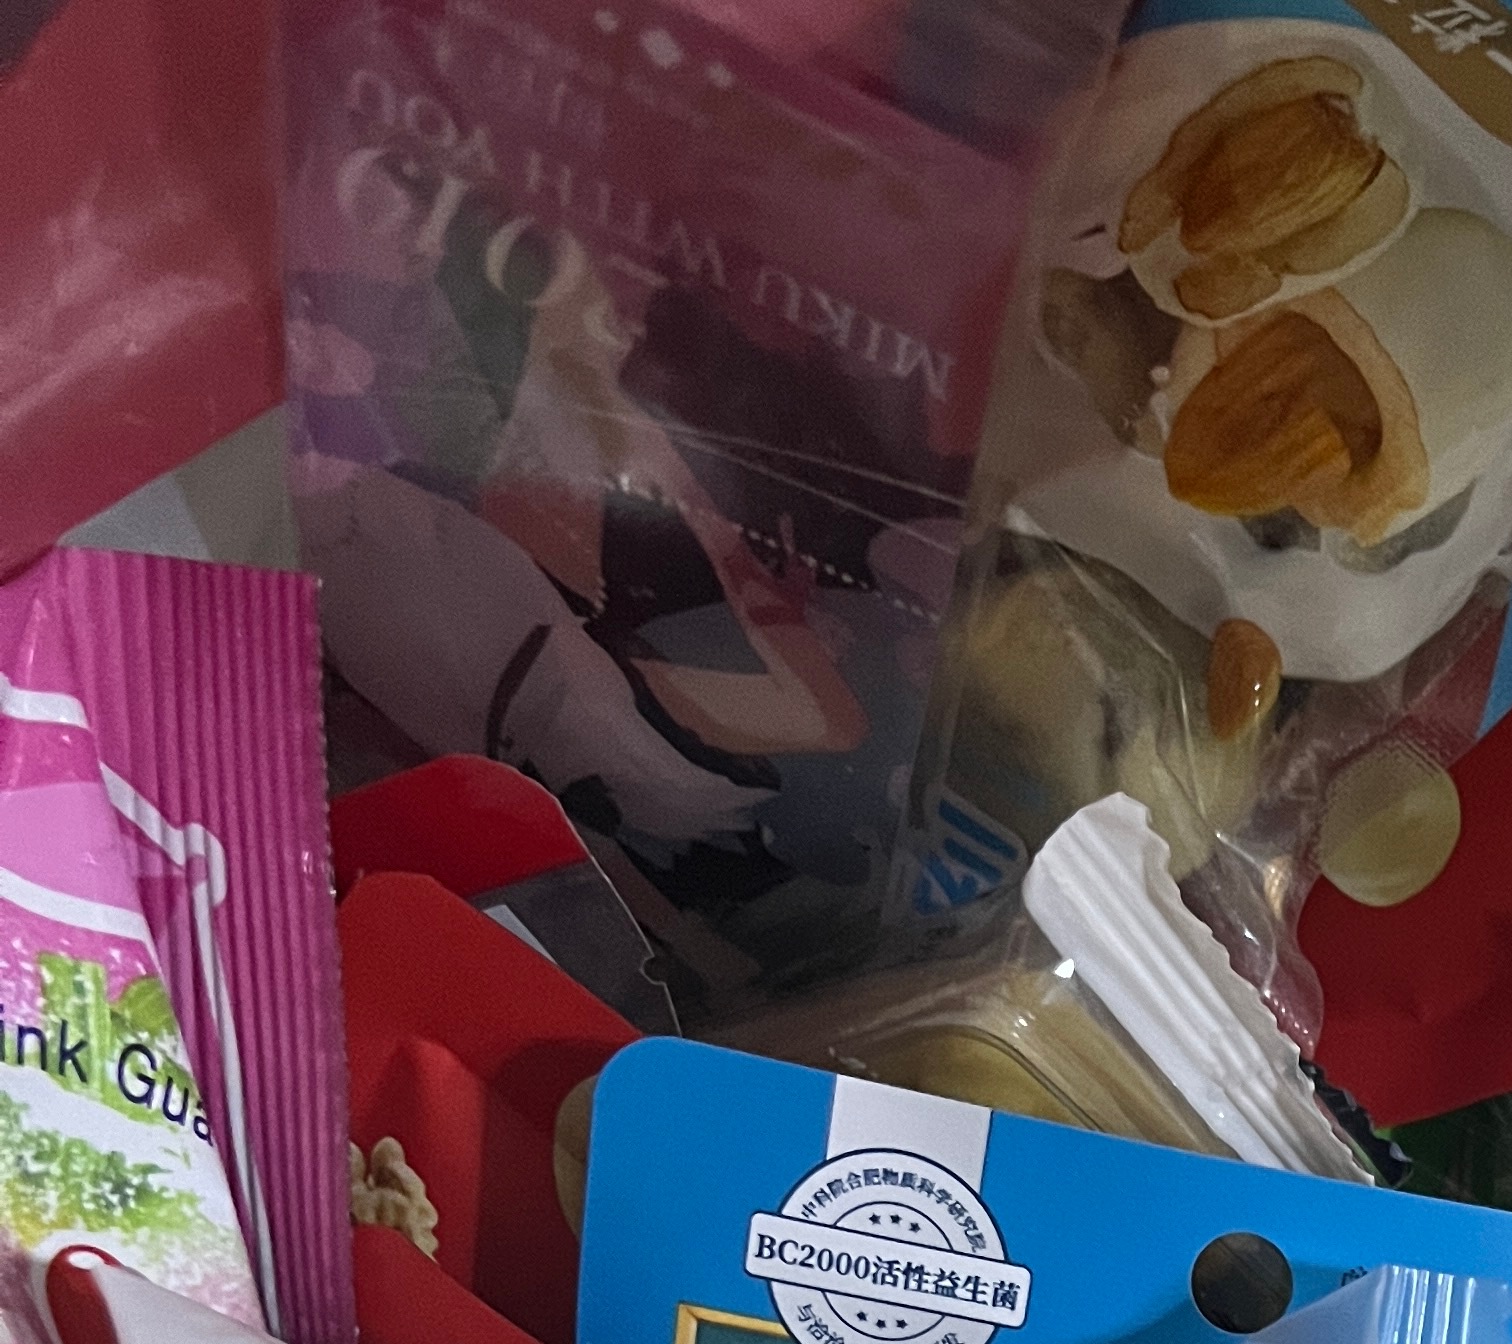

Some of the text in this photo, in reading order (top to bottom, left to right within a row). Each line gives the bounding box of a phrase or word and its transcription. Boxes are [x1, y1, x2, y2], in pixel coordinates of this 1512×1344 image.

[753, 1231, 1022, 1313] BC2000活性益生菌
